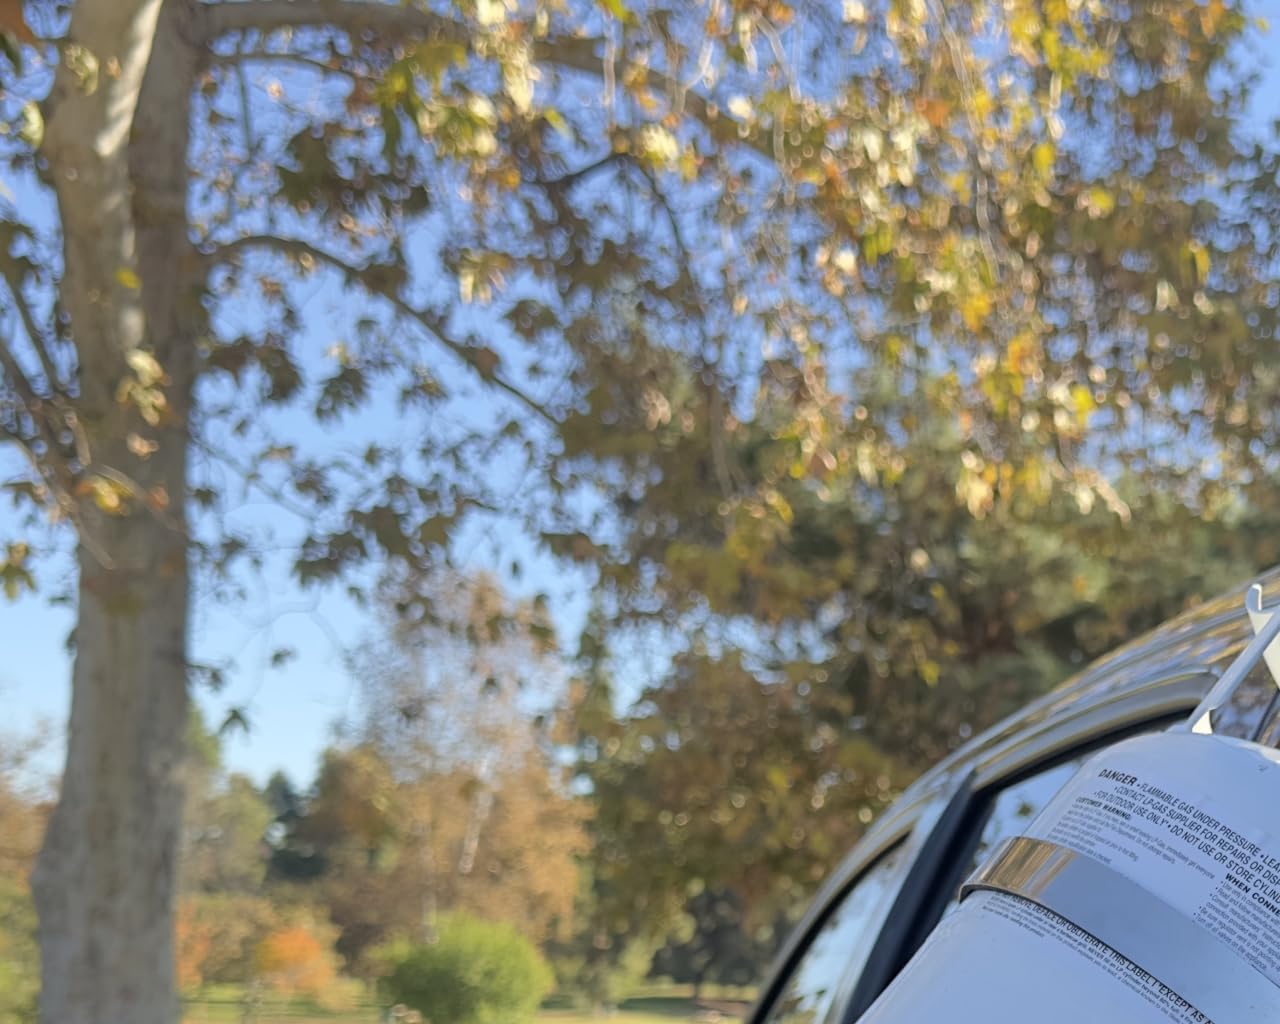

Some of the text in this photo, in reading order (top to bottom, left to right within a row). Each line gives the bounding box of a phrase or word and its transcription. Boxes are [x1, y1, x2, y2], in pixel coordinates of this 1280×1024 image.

[1098, 769, 1138, 785] DANGER
[1139, 783, 1180, 807] FLAMMABLE
[1176, 801, 1194, 814] GAS
[1191, 809, 1220, 830] UNDER
[1217, 825, 1261, 856] PRESSURE
[1105, 793, 1135, 811] OUTDOOR
[1132, 805, 1148, 817] USE
[1169, 824, 1184, 837] DO
[1181, 831, 1200, 846] NOT
[1197, 840, 1215, 856] USE
[1212, 850, 1227, 864] OR
[1225, 859, 1254, 883] STORE
[1115, 785, 1145, 802] CONTACT
[1141, 796, 1169, 814] LP-GAS
[1165, 808, 1202, 833] SUPPLIER
[1199, 827, 1218, 843] FOR
[1215, 838, 1251, 865] REPAIRS
[1248, 859, 1264, 874] OR
[1224, 872, 1251, 894] WHEN
[1055, 916, 1068, 927] OR
[1065, 922, 1110, 954] OBLITERATE
[1108, 950, 1127, 966] THIS
[1125, 961, 1153, 983] LABEL
[1190, 1008, 1205, 1023] AS
